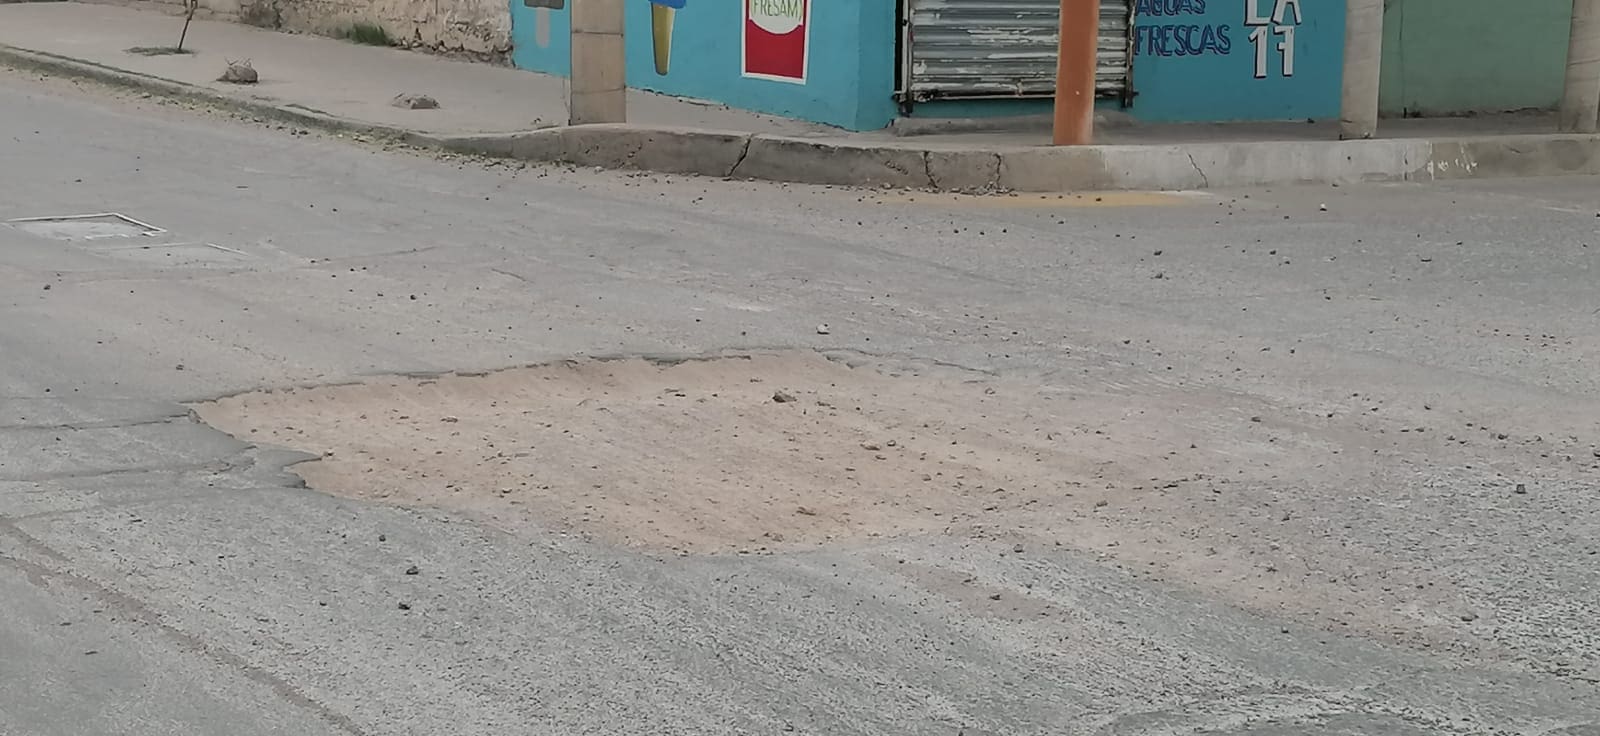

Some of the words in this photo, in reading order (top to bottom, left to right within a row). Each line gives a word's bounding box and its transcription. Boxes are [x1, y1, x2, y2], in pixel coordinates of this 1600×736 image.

[1244, 0, 1302, 25] LA
[1134, 24, 1232, 56] FRESCAS
[1248, 25, 1294, 78] 17
